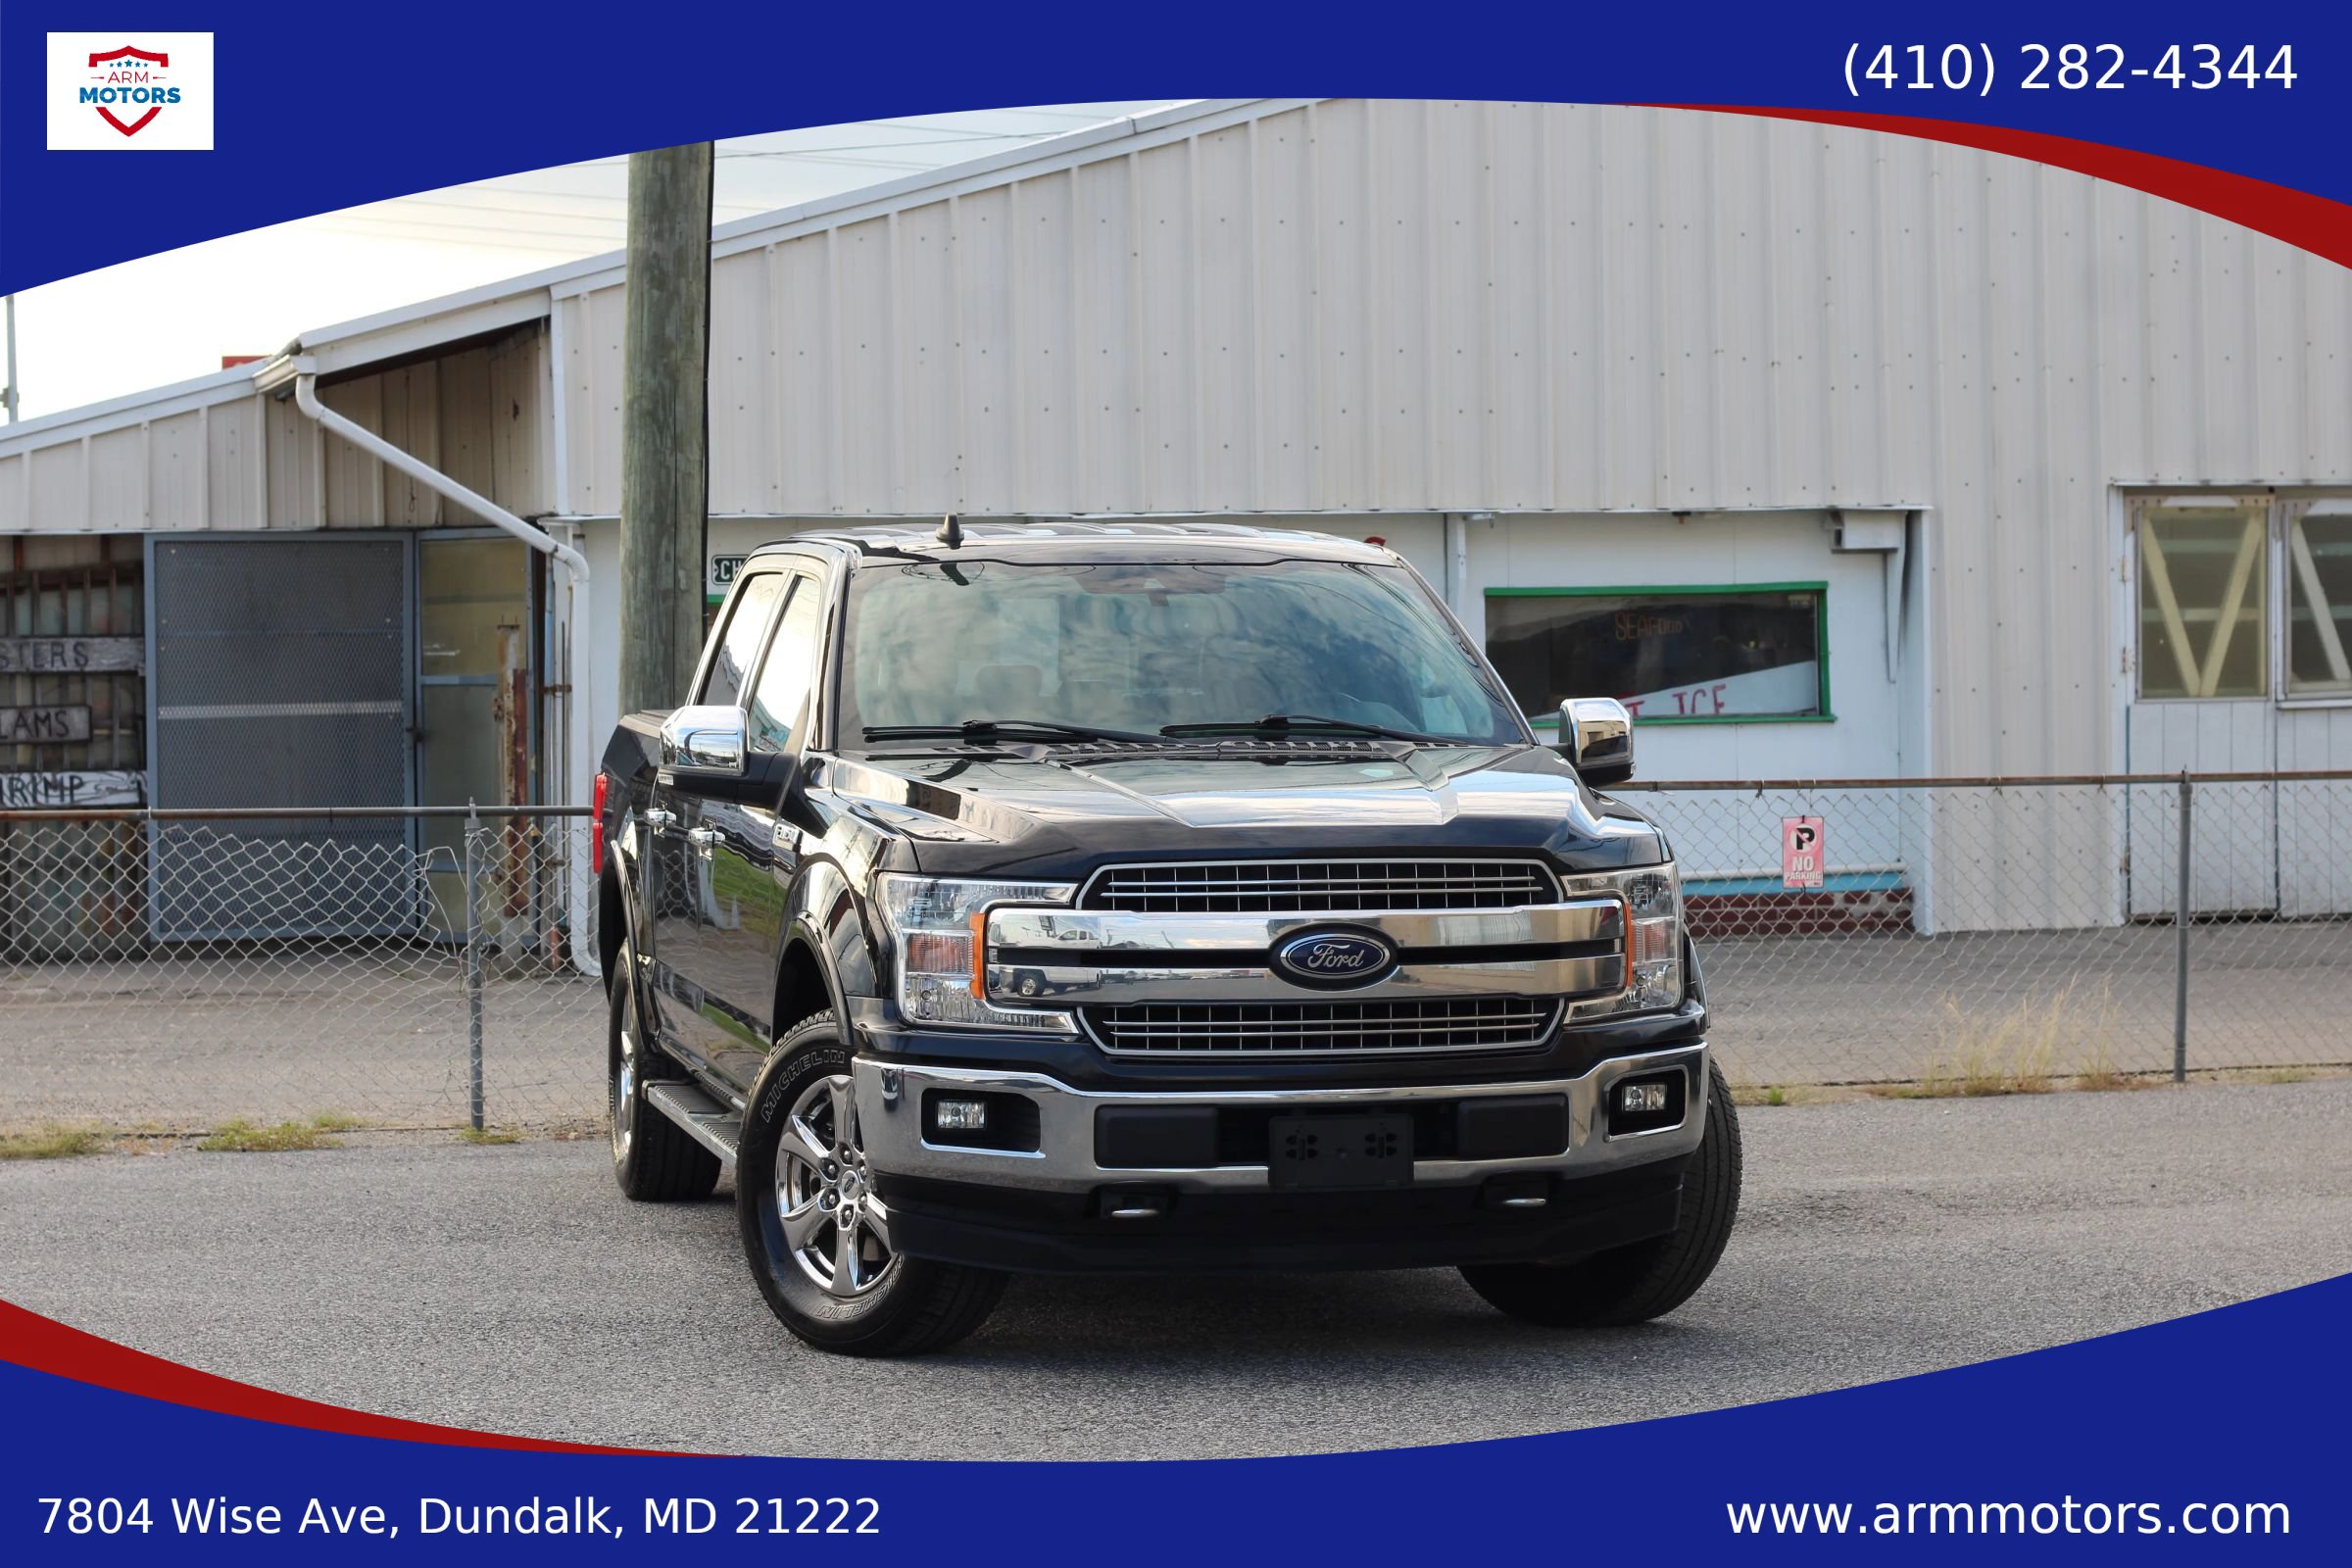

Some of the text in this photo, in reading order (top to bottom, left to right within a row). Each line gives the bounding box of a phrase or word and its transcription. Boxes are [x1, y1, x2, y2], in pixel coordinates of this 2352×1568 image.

[0, 774, 84, 805] RIMP
[1786, 871, 1822, 881] PARKING
[1792, 856, 1815, 872] NO
[1307, 943, 1365, 968] Ford
[760, 1049, 846, 1123] MICHELIN
